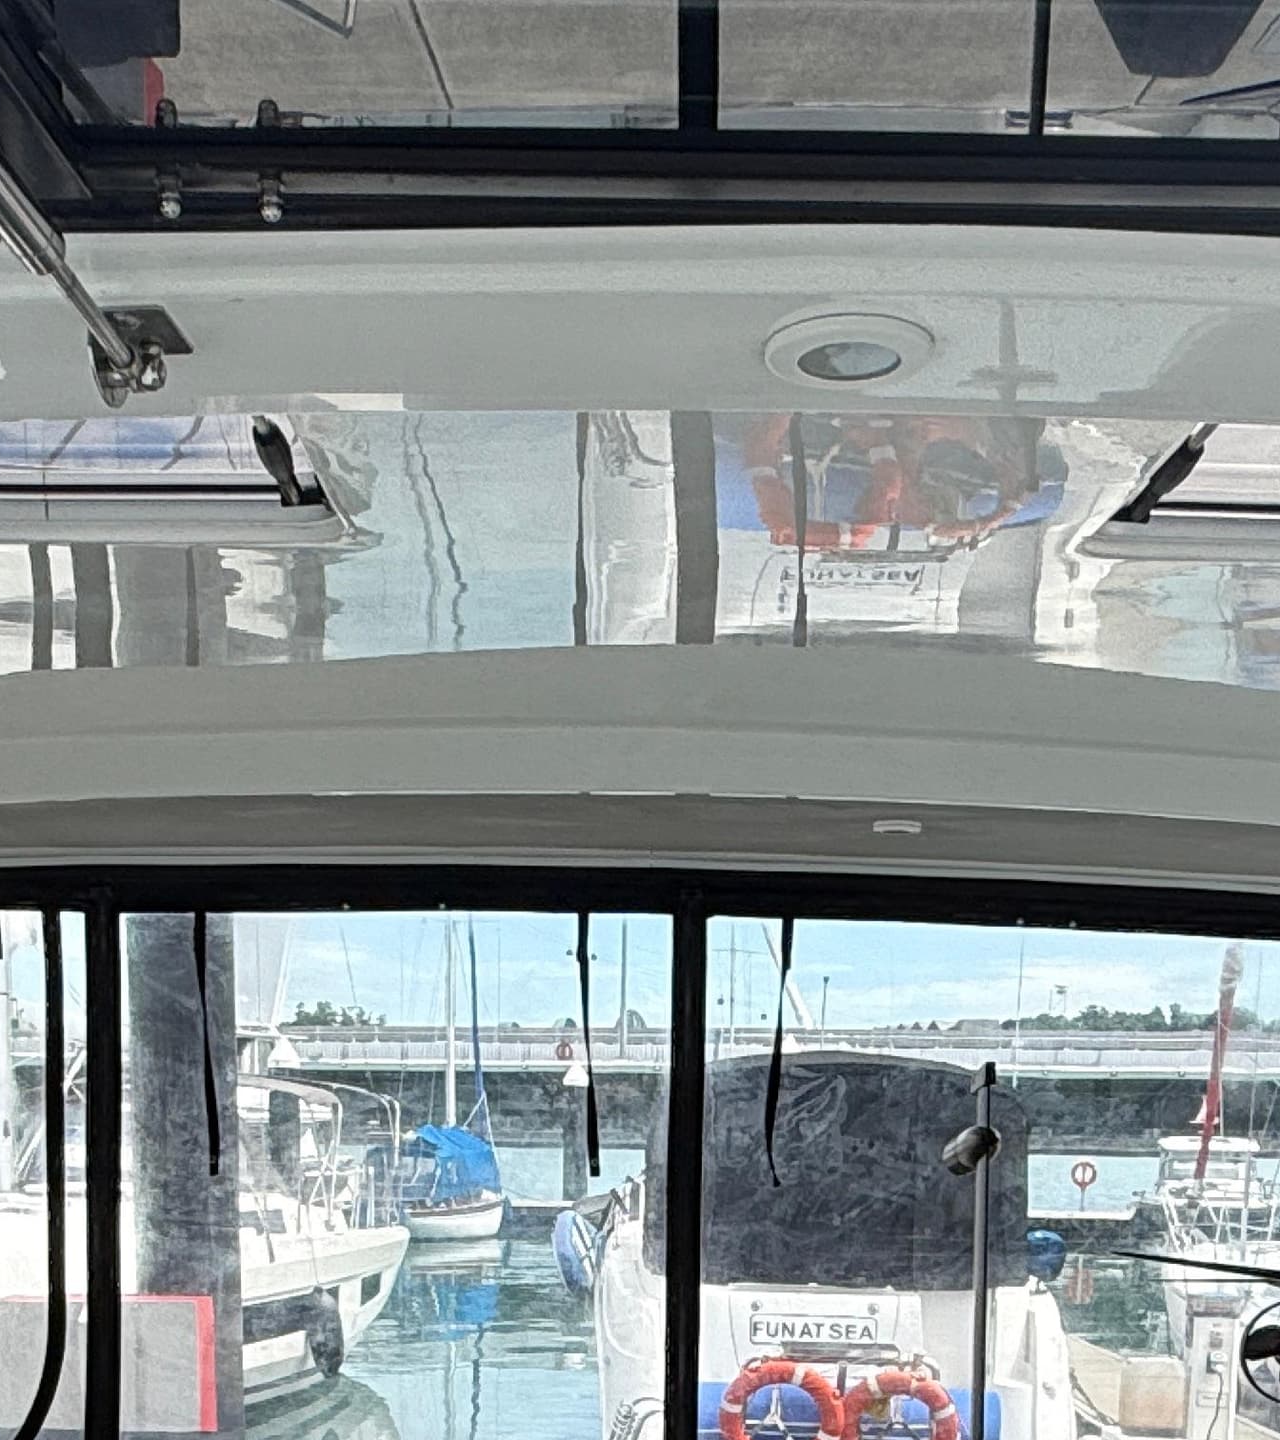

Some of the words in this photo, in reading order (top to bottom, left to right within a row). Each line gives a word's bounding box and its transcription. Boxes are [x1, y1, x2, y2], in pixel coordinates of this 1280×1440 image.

[752, 1320, 795, 1338] FUN
[799, 1321, 824, 1339] AT
[828, 1323, 874, 1340] SEA
